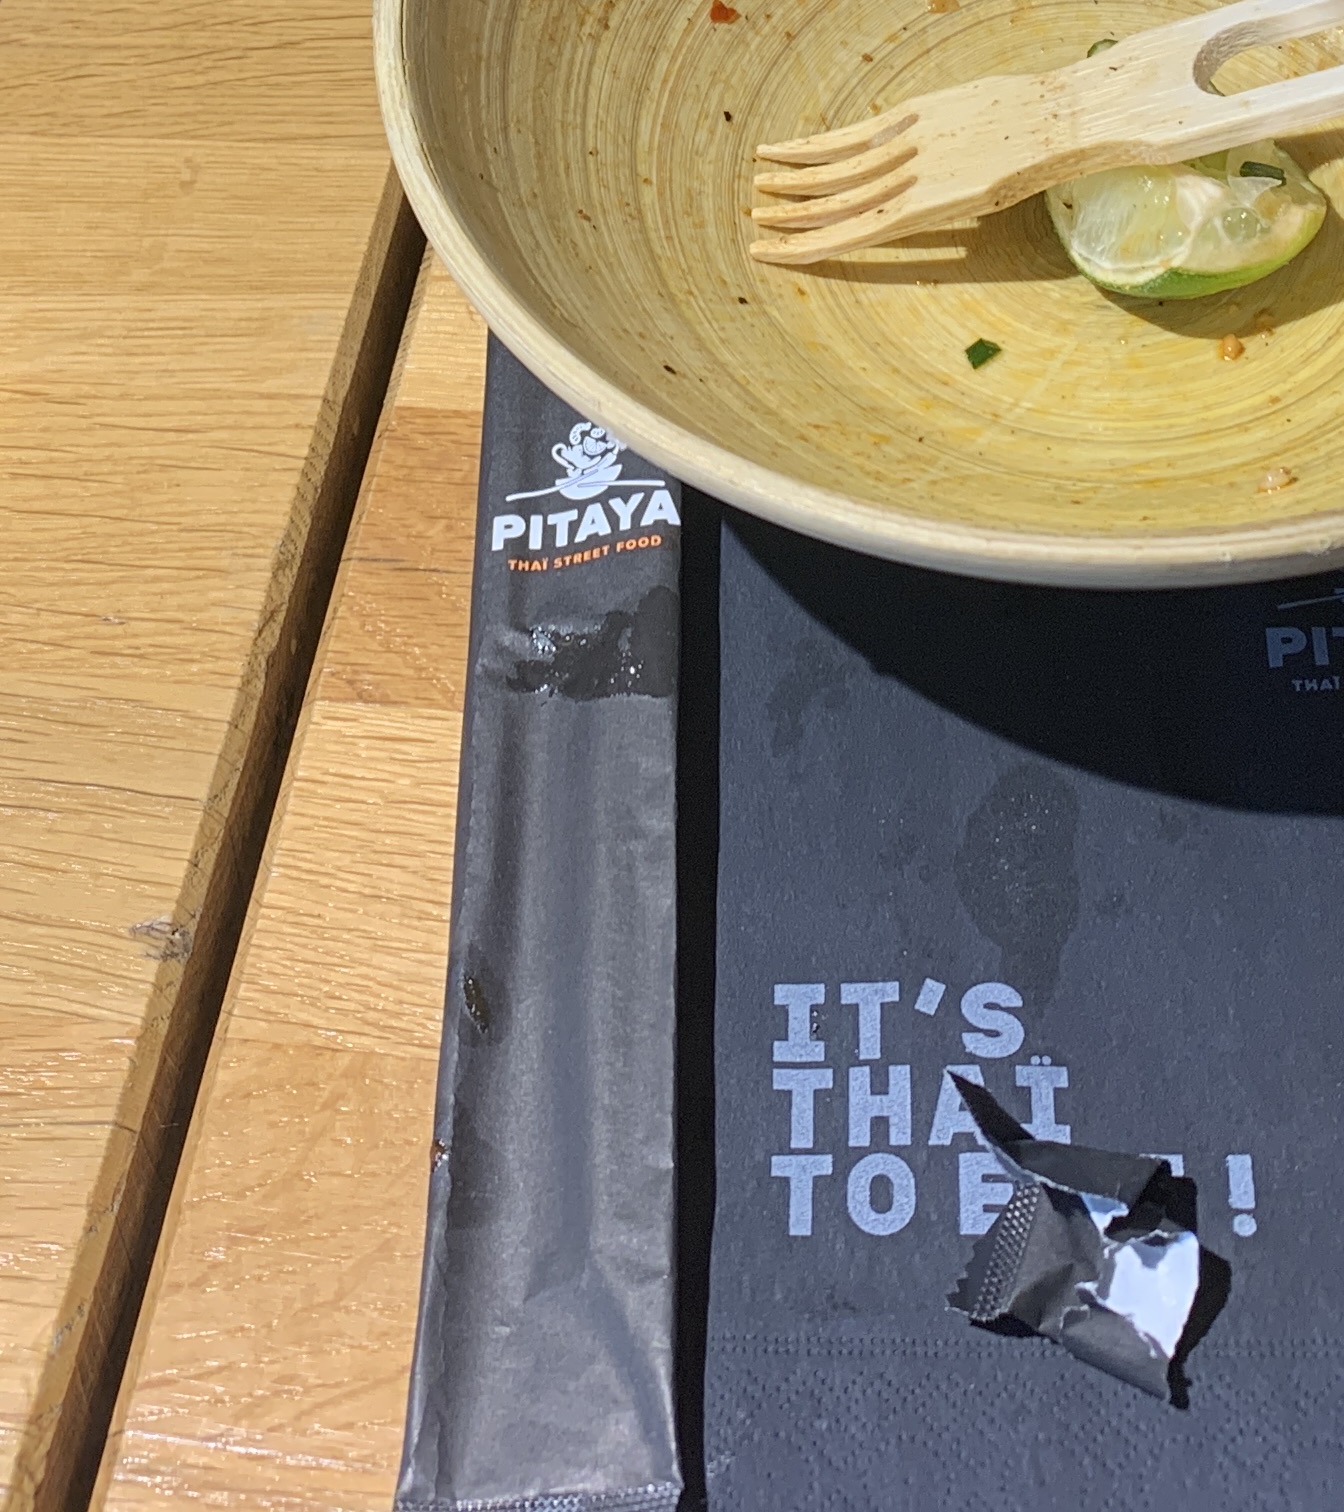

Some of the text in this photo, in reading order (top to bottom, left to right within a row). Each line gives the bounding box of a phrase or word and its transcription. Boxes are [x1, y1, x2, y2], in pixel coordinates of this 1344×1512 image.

[491, 489, 682, 552] PITAYA
[508, 534, 663, 572] THAÏ STREET FOOD
[1291, 675, 1341, 692] THAÏ
[772, 978, 1026, 1063] IT'S
[772, 1055, 1072, 1149] THAÏ
[771, 1152, 917, 1236] TO
